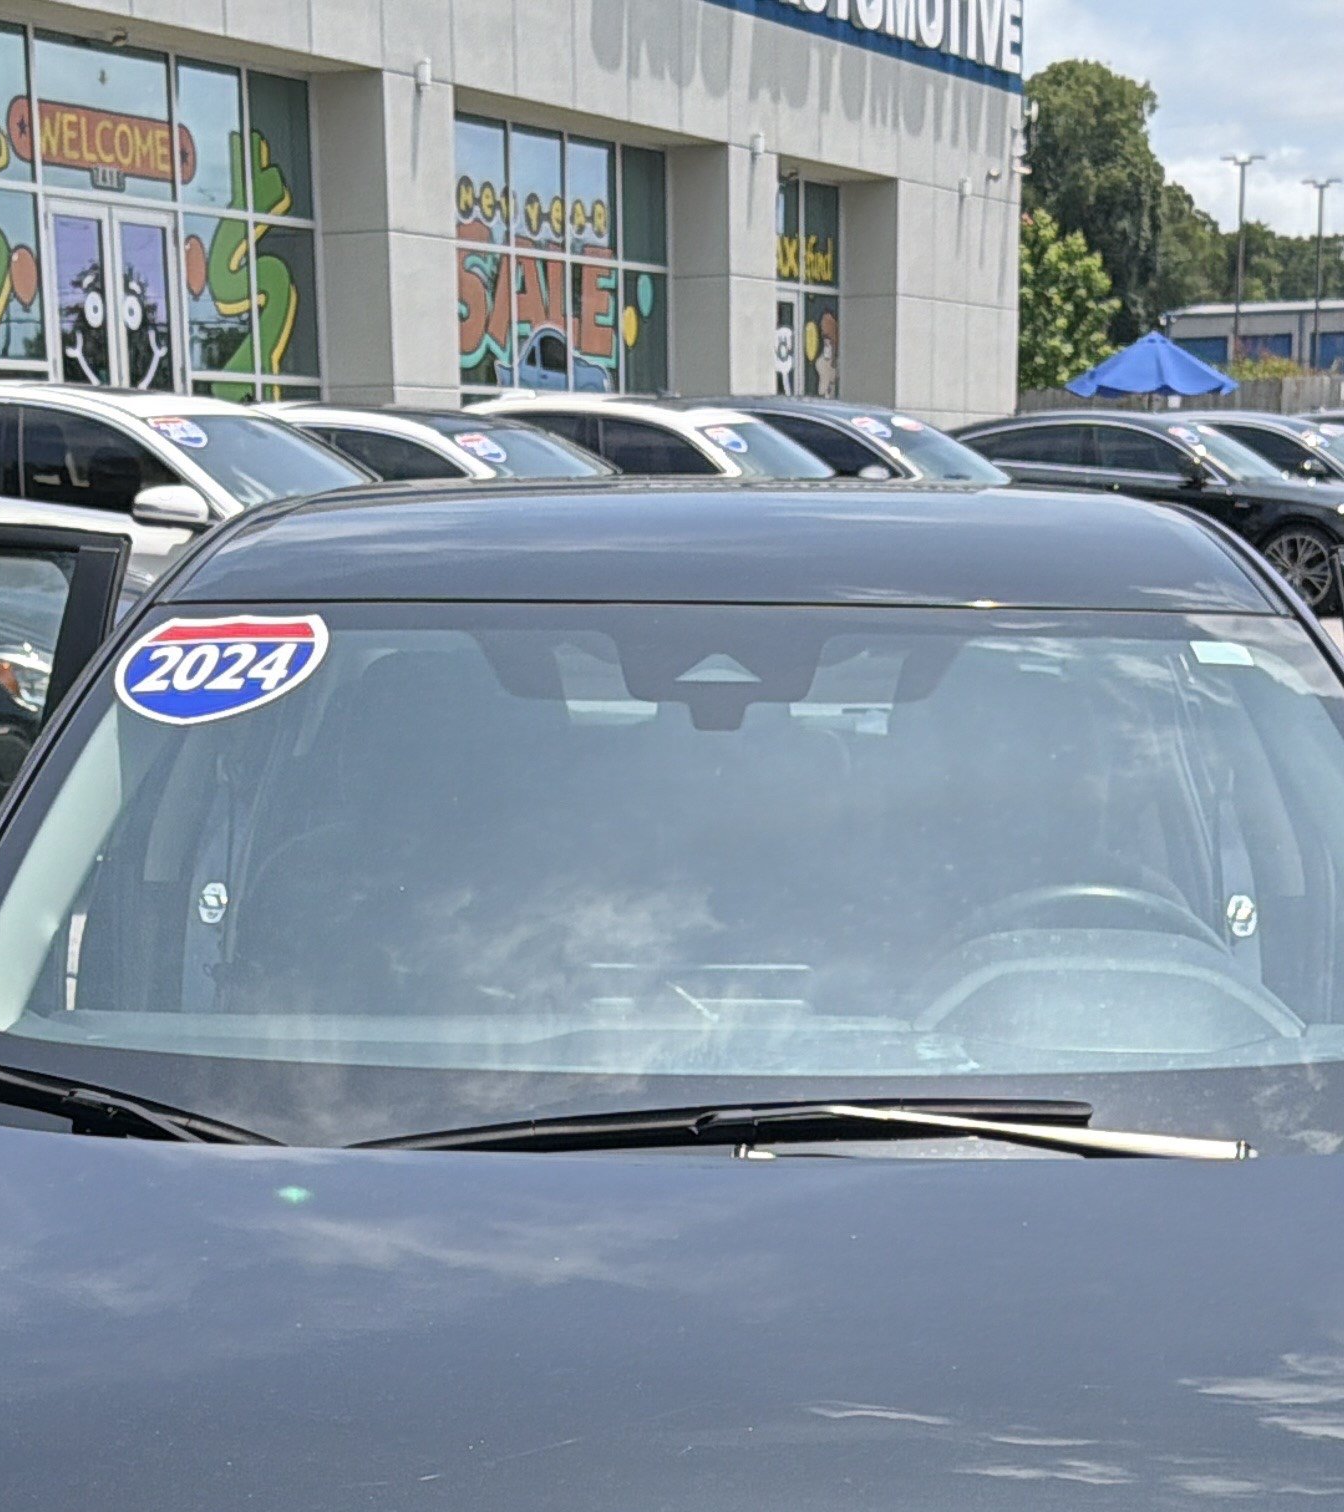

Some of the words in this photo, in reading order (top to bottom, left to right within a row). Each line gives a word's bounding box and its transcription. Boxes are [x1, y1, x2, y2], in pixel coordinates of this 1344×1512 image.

[778, 0, 1020, 74] MOTIVE
[40, 111, 173, 174] WELCOME
[130, 642, 298, 692] 2024
